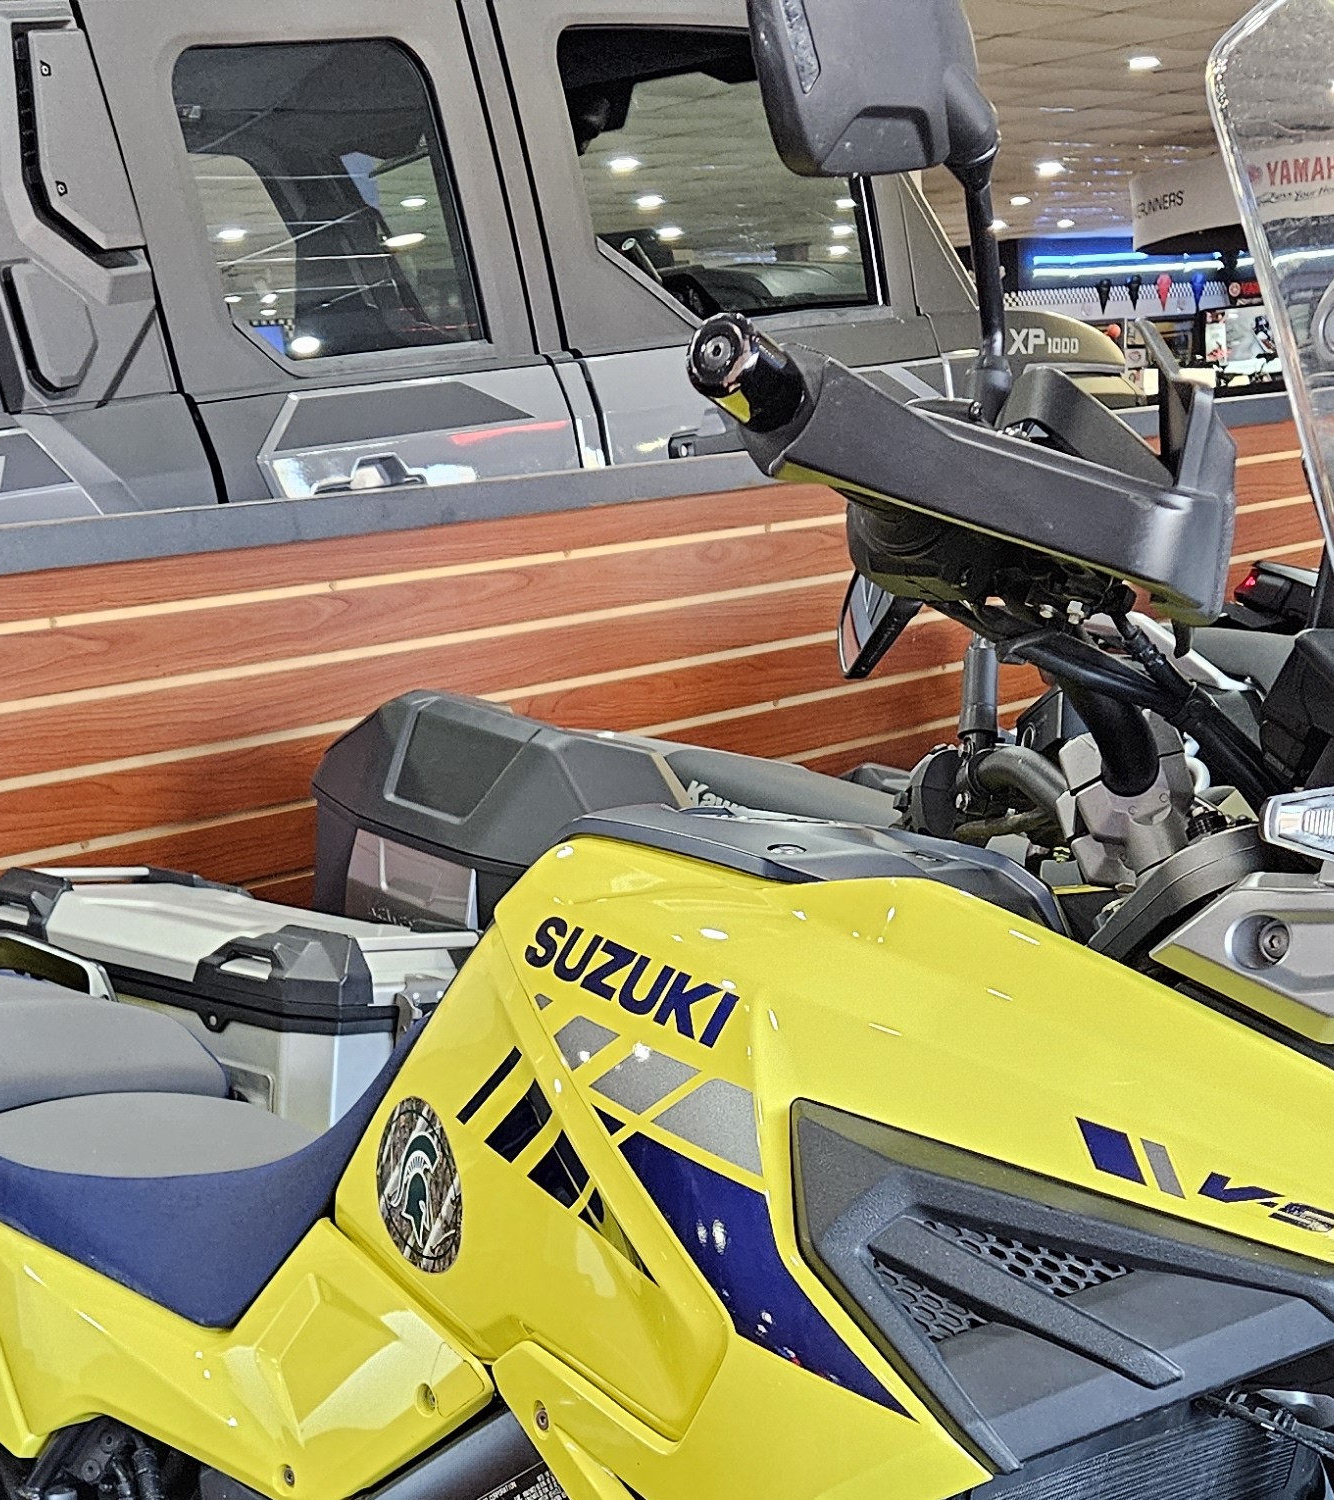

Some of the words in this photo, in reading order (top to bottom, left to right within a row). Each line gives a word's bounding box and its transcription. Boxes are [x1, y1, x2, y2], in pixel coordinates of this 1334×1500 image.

[1007, 327, 1046, 356] XP
[1047, 337, 1079, 354] 1000
[524, 916, 741, 1049] SUZUKI
